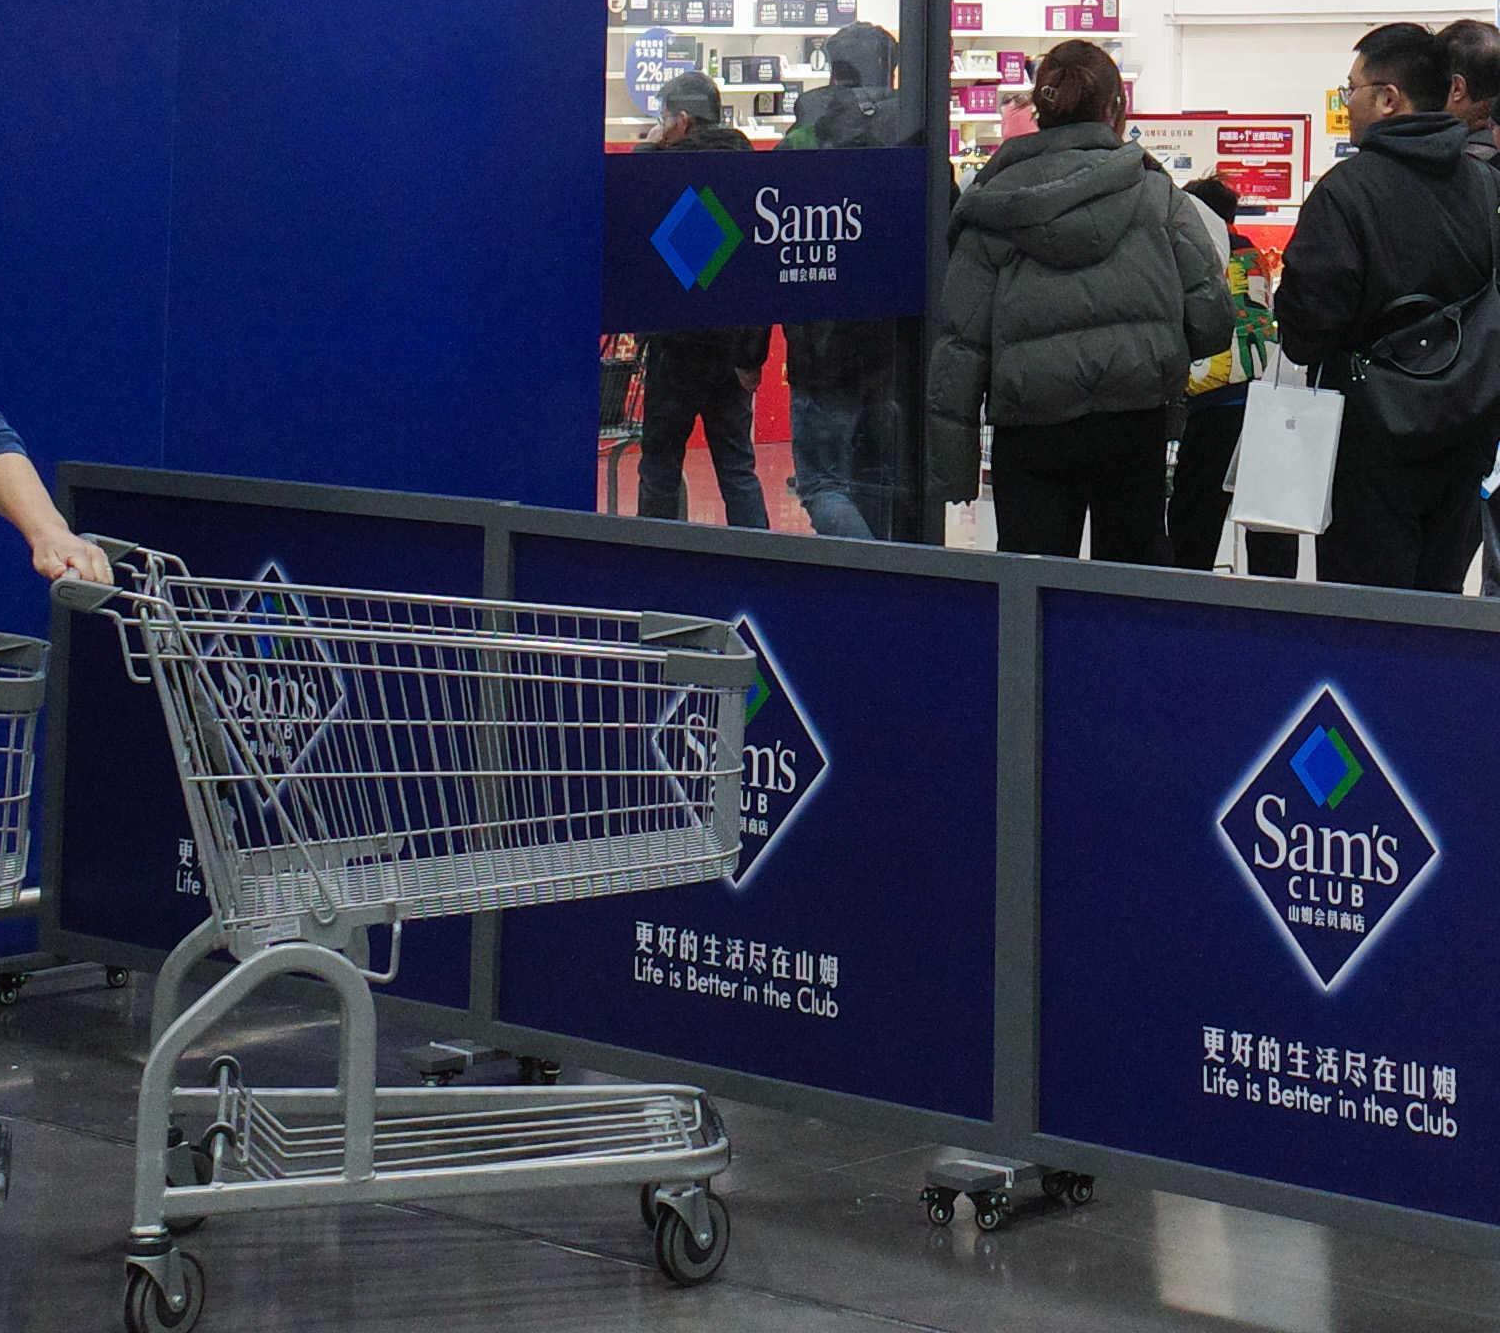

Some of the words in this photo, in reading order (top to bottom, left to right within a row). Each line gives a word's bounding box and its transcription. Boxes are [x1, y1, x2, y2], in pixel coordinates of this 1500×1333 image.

[754, 186, 862, 244] Sam's
[779, 244, 837, 265] CLUB
[682, 713, 797, 794] Sm's
[1254, 794, 1399, 885] Sam's
[176, 870, 201, 896] Life
[1288, 875, 1365, 908] CLUB
[1288, 904, 1366, 934] 山姆会员商店
[635, 920, 839, 989] 更好的生活尽在山姆
[634, 956, 664, 985] Life
[669, 962, 682, 988] is
[687, 965, 739, 999] Better
[743, 976, 758, 1003] in
[763, 980, 792, 1009] the
[797, 986, 839, 1018] Club
[1202, 1025, 1457, 1105] 更好的生活尽在山姆
[1203, 1065, 1240, 1098] Life
[1246, 1073, 1262, 1102] is
[1268, 1076, 1333, 1115] Better
[1338, 1089, 1357, 1120] in
[1363, 1093, 1399, 1128] the
[1406, 1101, 1458, 1138] Club
